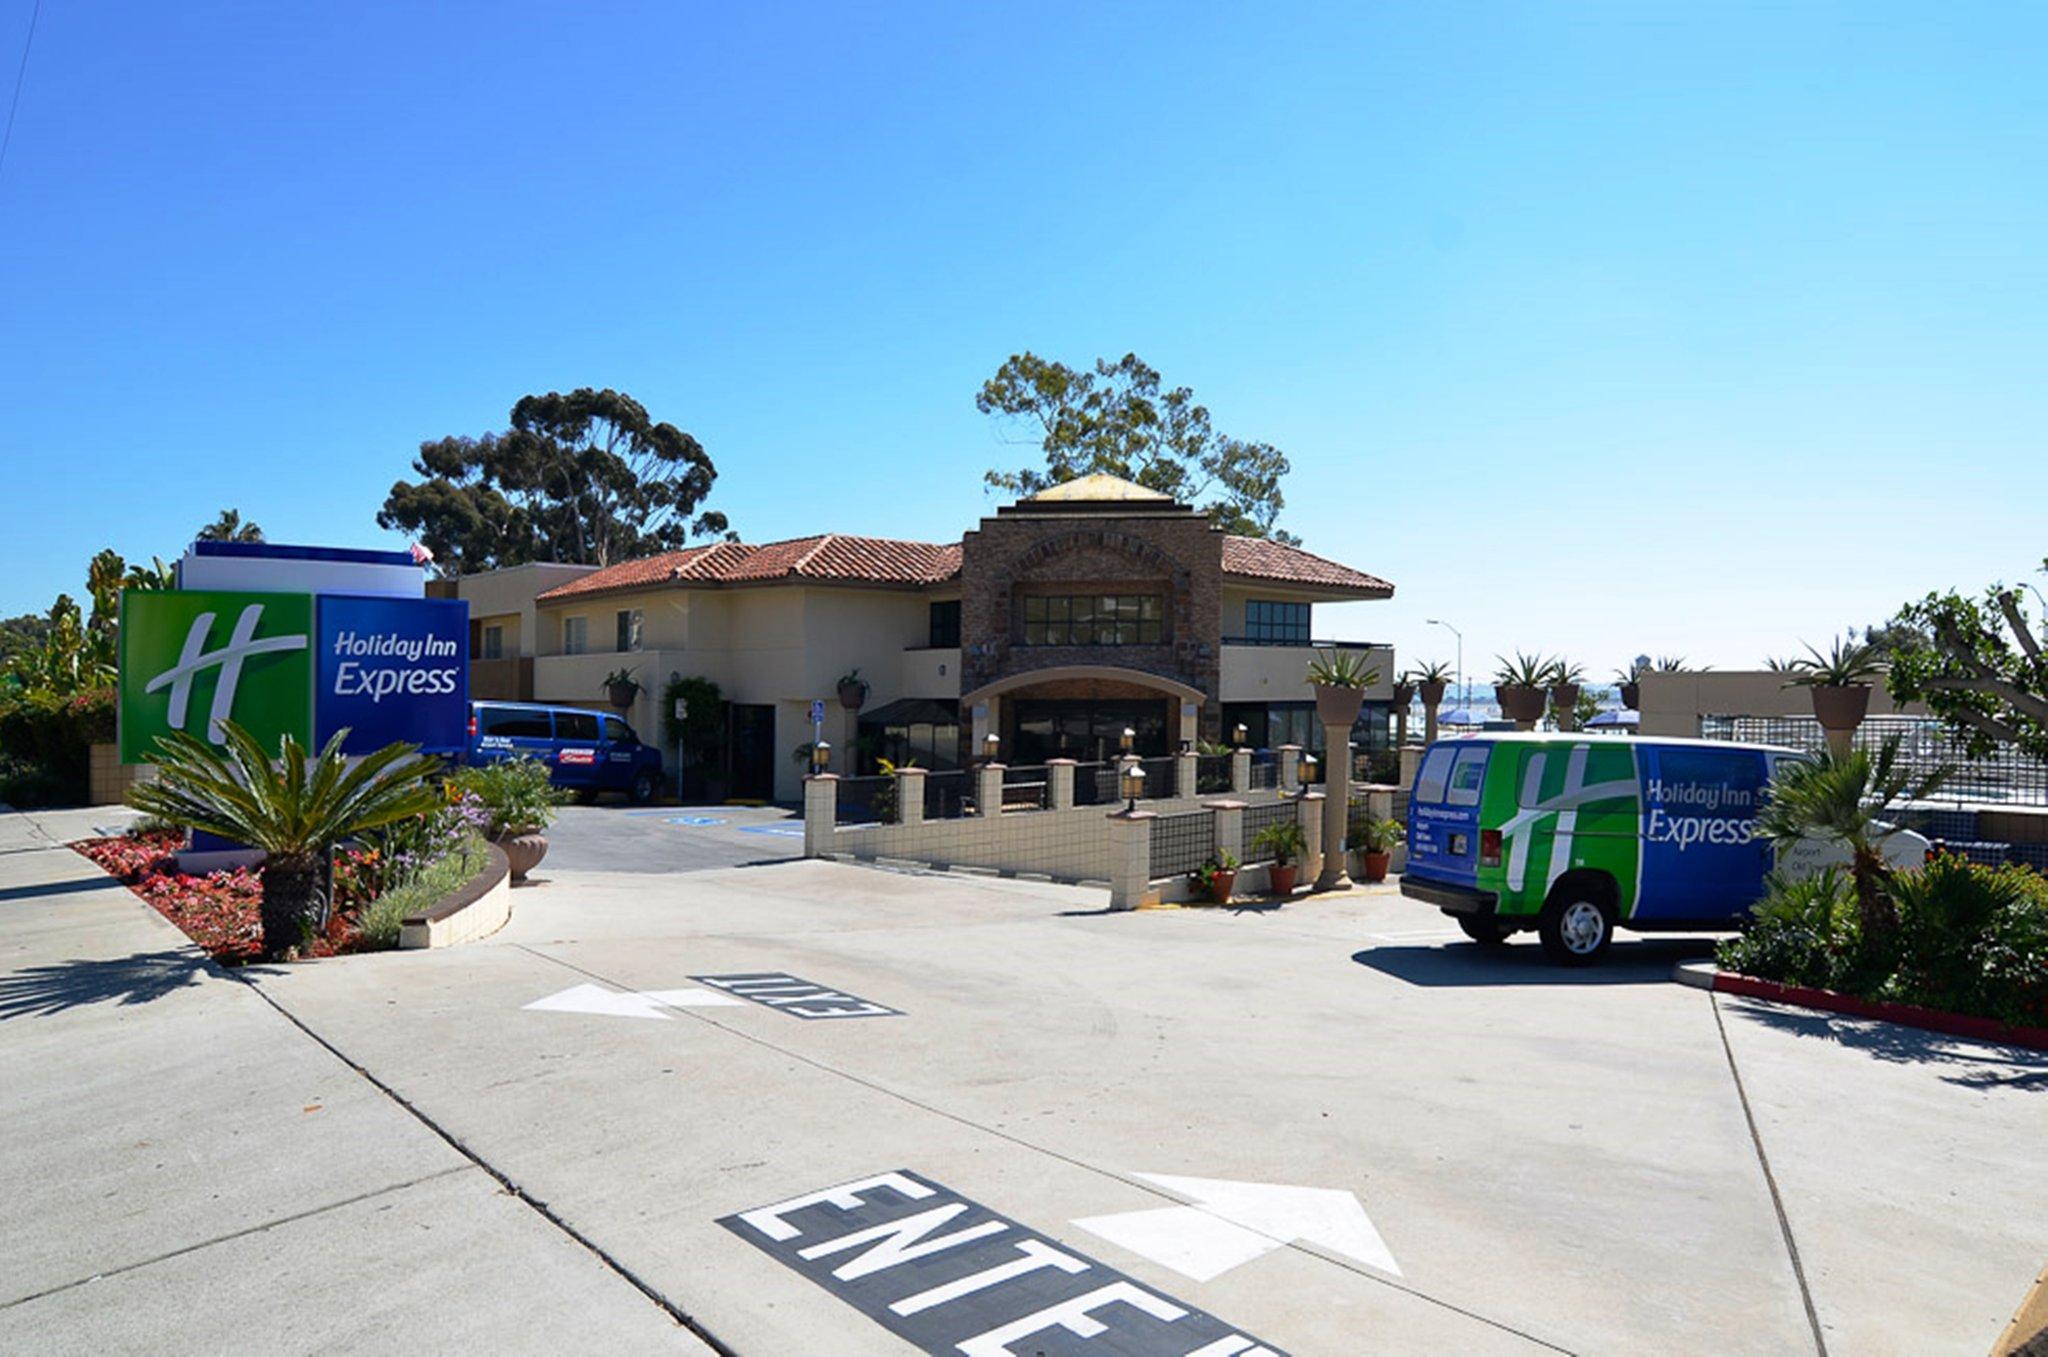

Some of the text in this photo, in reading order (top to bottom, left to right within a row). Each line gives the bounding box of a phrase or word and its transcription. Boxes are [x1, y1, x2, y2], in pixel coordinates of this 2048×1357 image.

[334, 631, 457, 662] Holiday Inn
[334, 662, 457, 703] Express
[1647, 779, 1750, 810] Holiday Inn
[1649, 809, 1752, 851] Express
[702, 977, 894, 1017] EXIT
